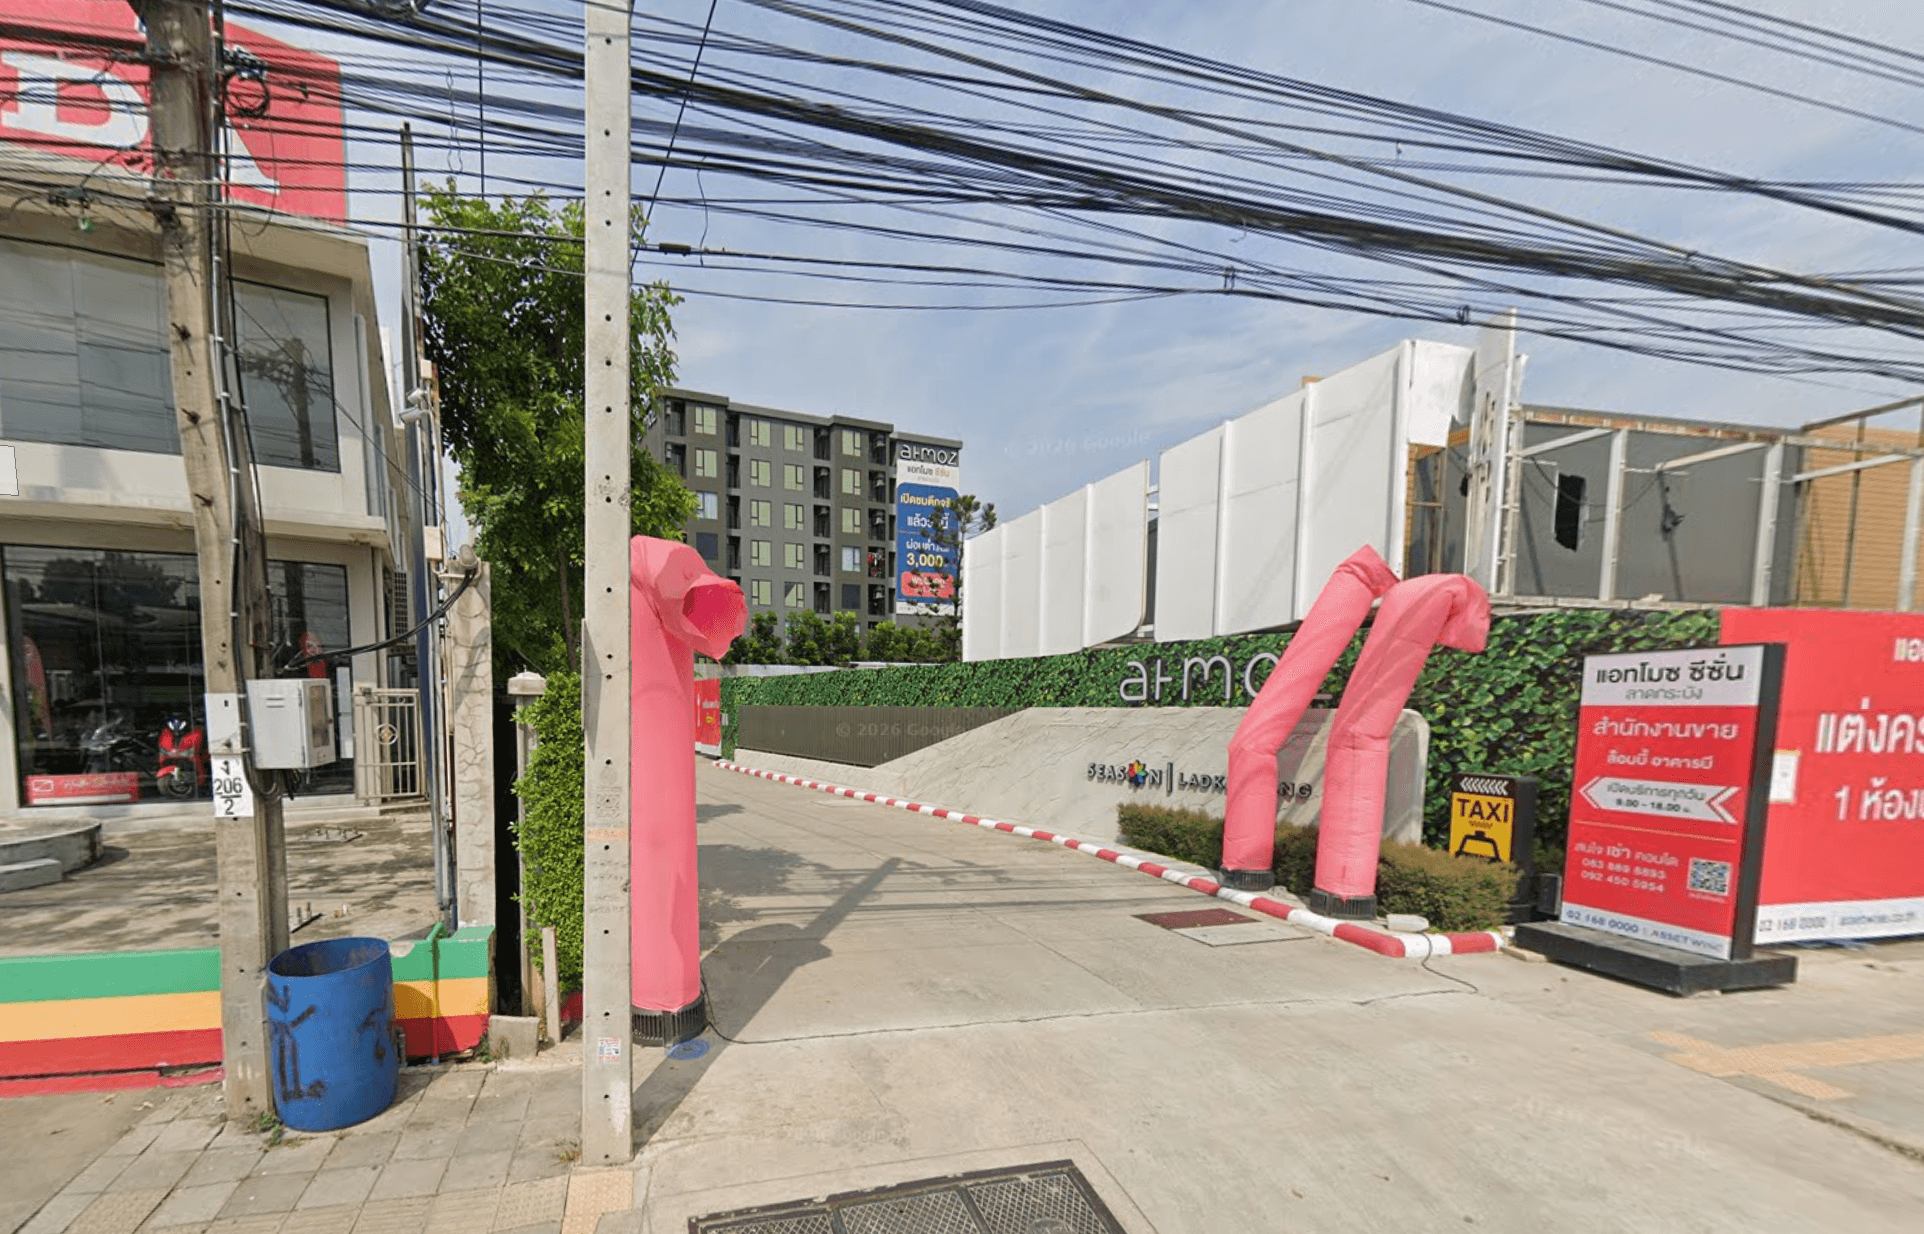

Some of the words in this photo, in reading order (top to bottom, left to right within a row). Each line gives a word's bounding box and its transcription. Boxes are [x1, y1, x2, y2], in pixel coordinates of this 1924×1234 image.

[1119, 652, 1333, 701] atmo
[1689, 653, 1744, 681] ซีซั่น
[1593, 716, 1739, 740] สำนักงานขาย
[214, 777, 243, 795] 206
[224, 798, 235, 816] 2
[1456, 798, 1509, 823] TAXI
[1835, 785, 1850, 821] 1
